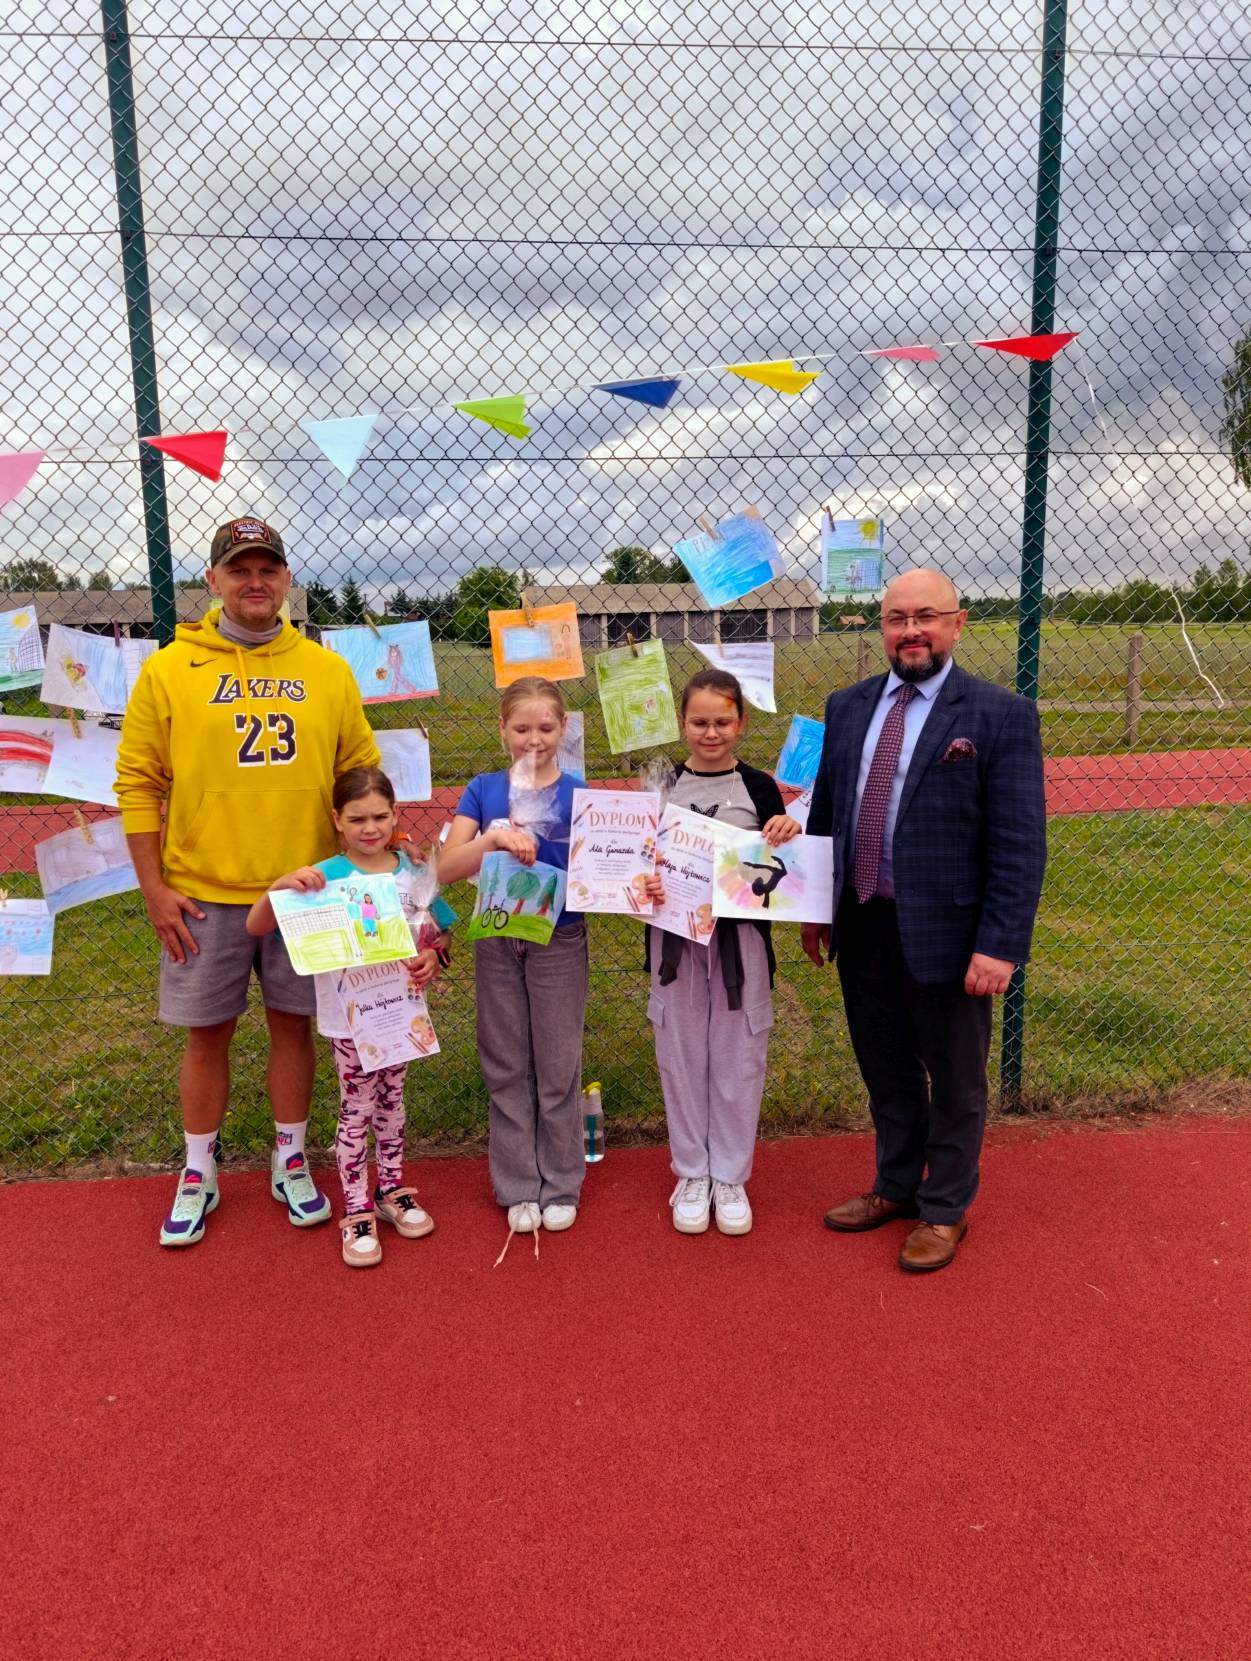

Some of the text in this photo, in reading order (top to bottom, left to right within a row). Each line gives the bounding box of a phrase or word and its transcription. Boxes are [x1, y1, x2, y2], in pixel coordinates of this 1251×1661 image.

[208, 673, 306, 704] LAKERS
[234, 712, 297, 767] 23
[589, 811, 646, 829] DYPLOM
[348, 961, 401, 988] DYPLOM
